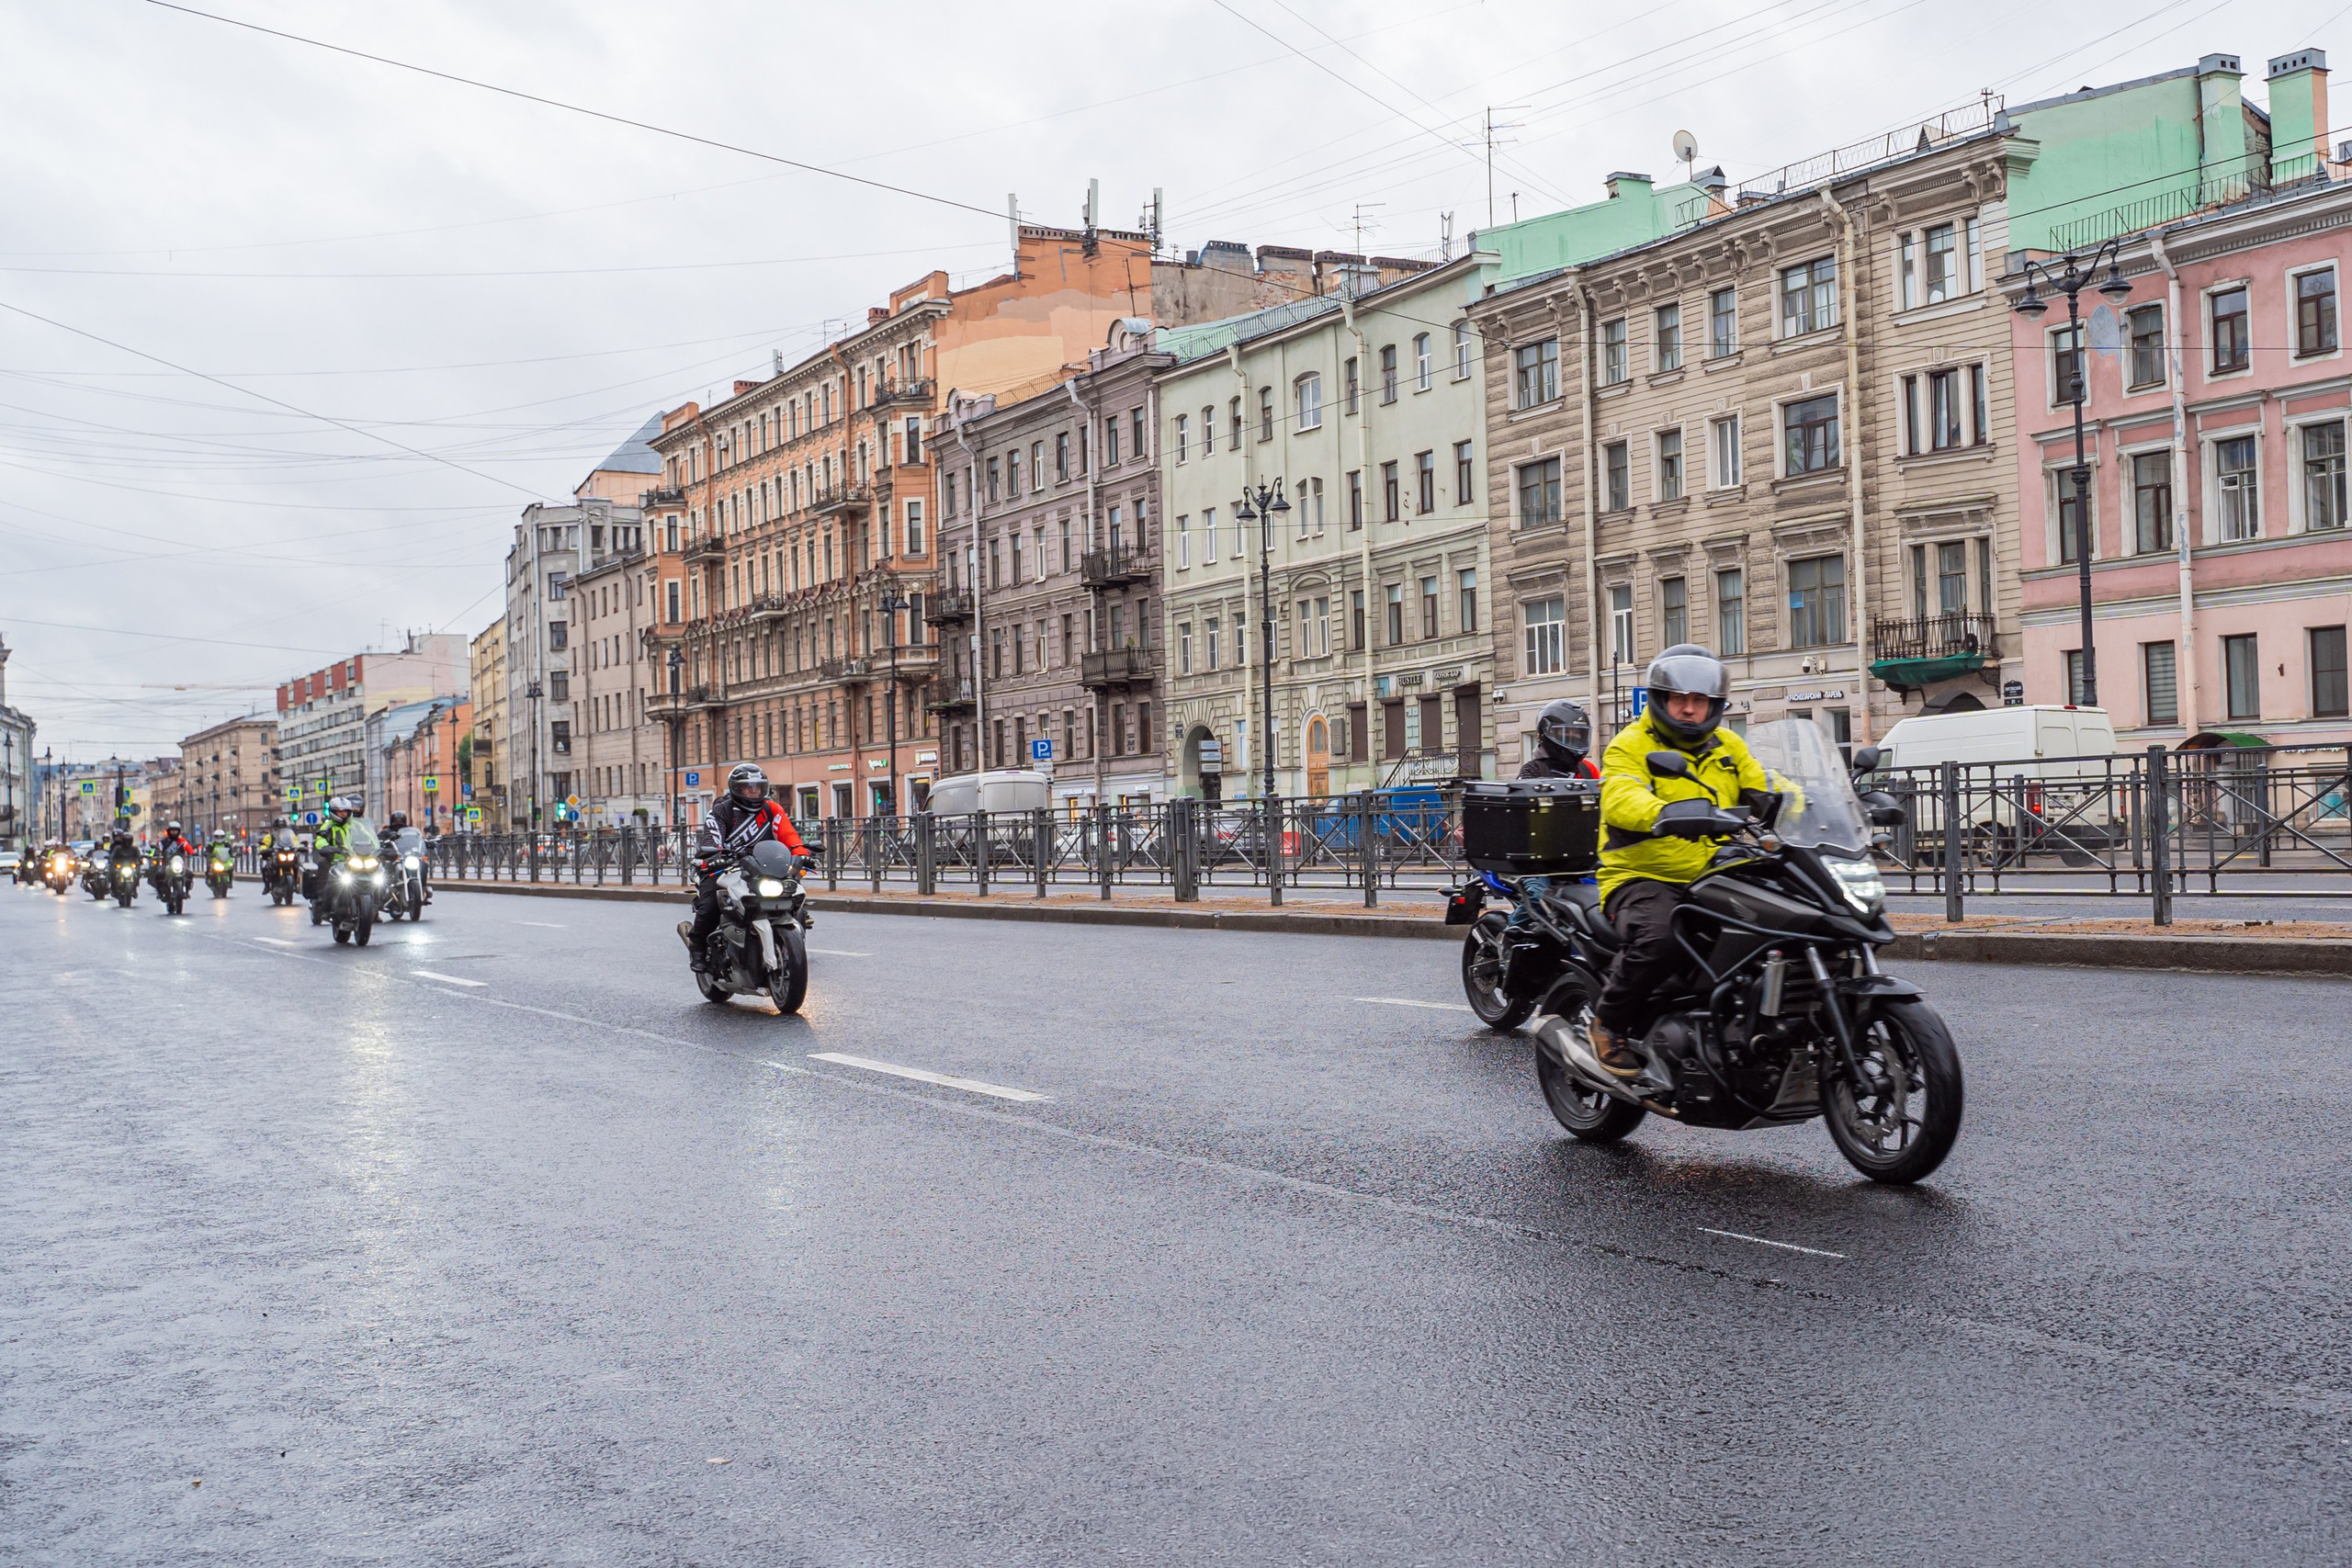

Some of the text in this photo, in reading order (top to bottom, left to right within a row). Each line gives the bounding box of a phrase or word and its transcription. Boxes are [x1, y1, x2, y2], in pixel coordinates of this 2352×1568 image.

[1398, 675, 1422, 686] HUSTLE
[1037, 741, 1048, 757] P
[689, 773, 697, 784] P
